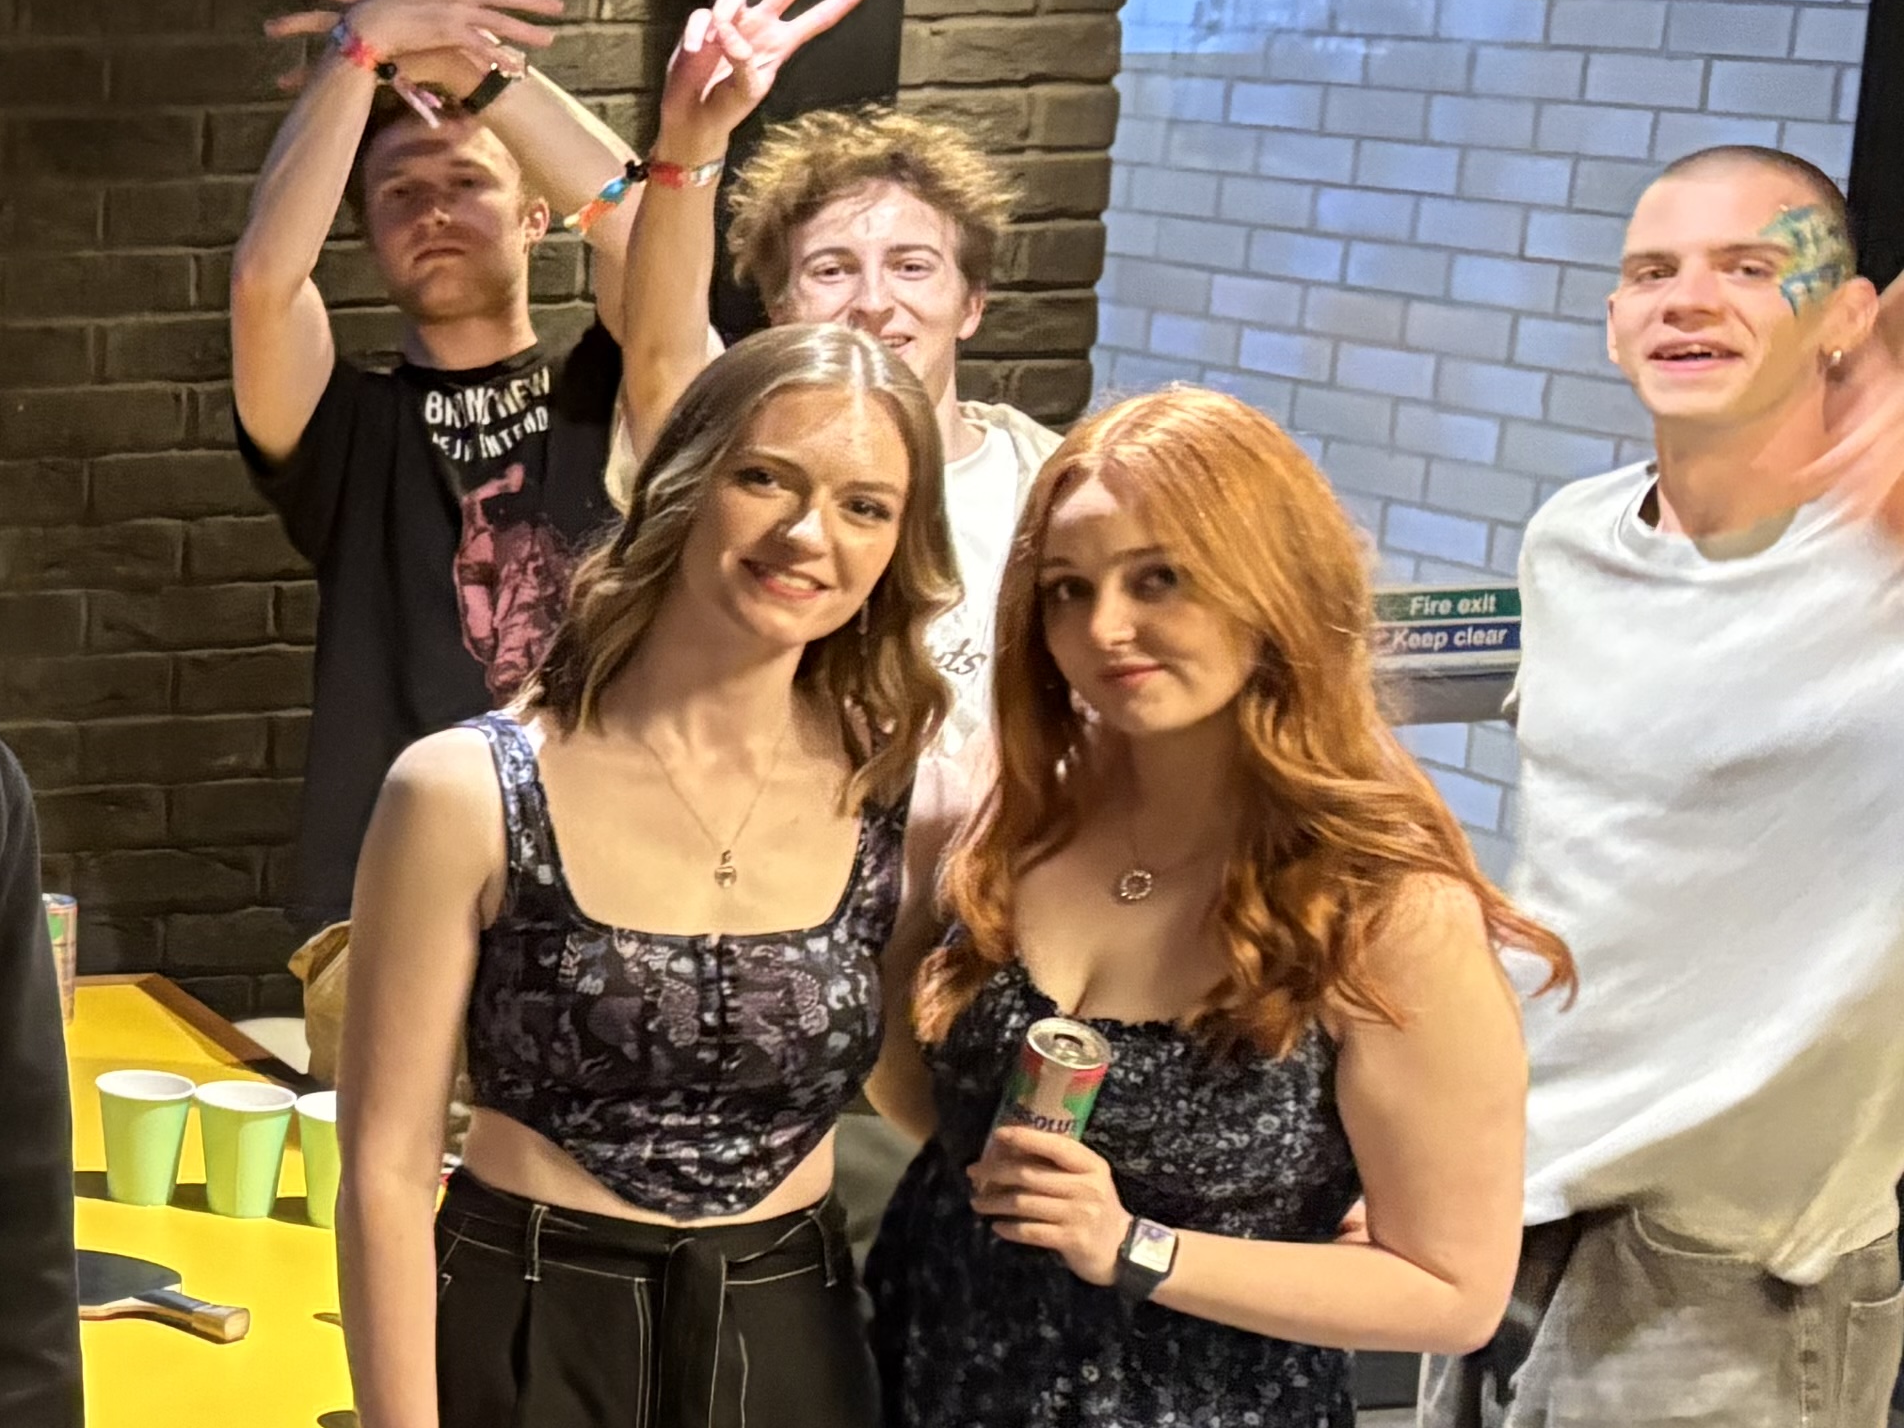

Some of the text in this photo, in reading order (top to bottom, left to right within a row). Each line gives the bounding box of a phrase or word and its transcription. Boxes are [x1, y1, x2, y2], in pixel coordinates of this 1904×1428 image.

[1410, 592, 1496, 616] Fire exit
[1393, 626, 1507, 651] Keep clear
